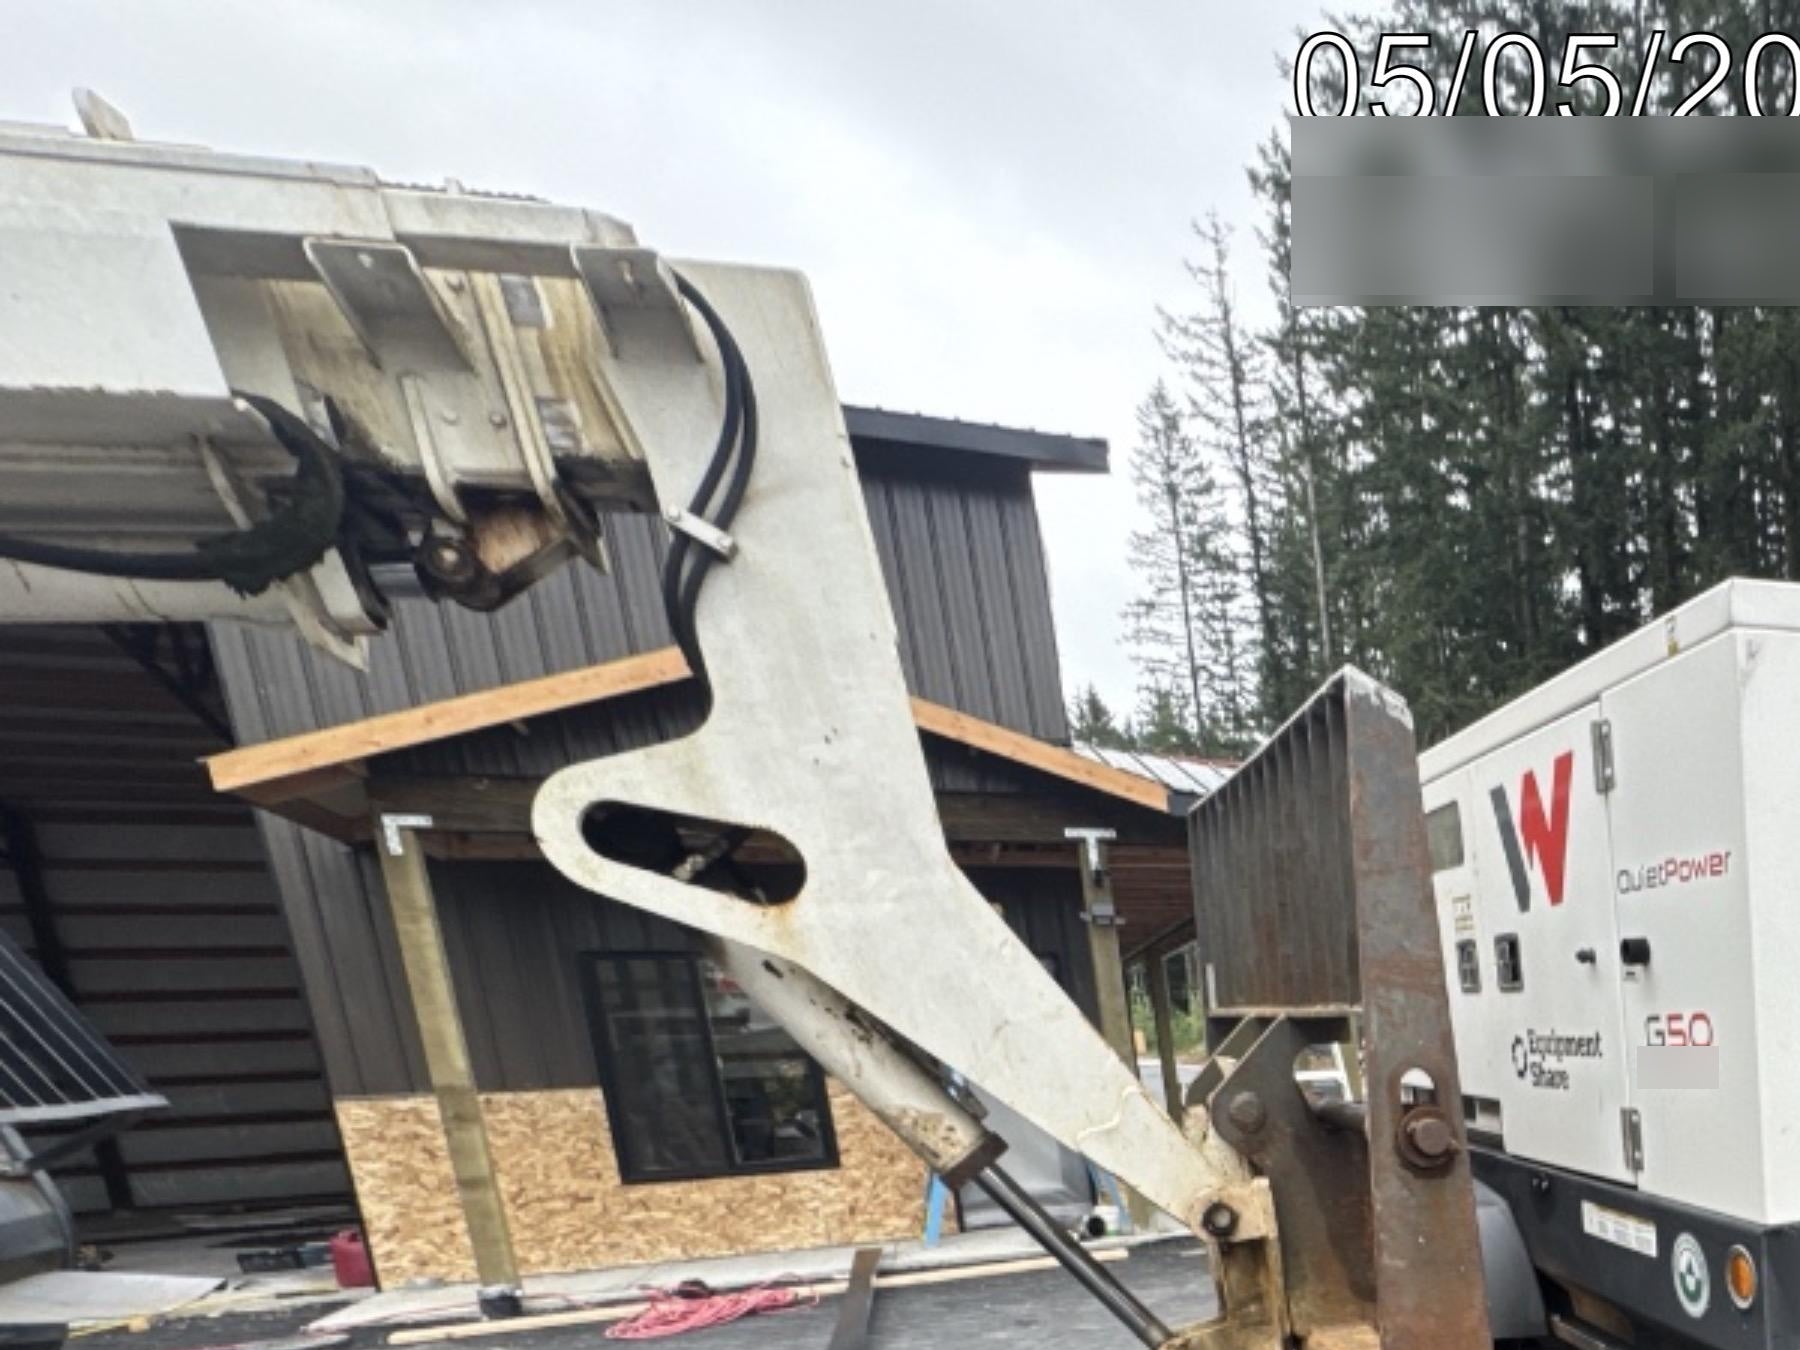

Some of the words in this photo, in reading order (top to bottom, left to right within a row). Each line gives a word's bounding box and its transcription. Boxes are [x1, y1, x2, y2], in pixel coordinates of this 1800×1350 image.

[1616, 850, 1732, 895] QuietPower
[1526, 1028, 1604, 1064] Equipment
[1646, 1012, 1714, 1046] G50
[1529, 1060, 1570, 1090] Share
